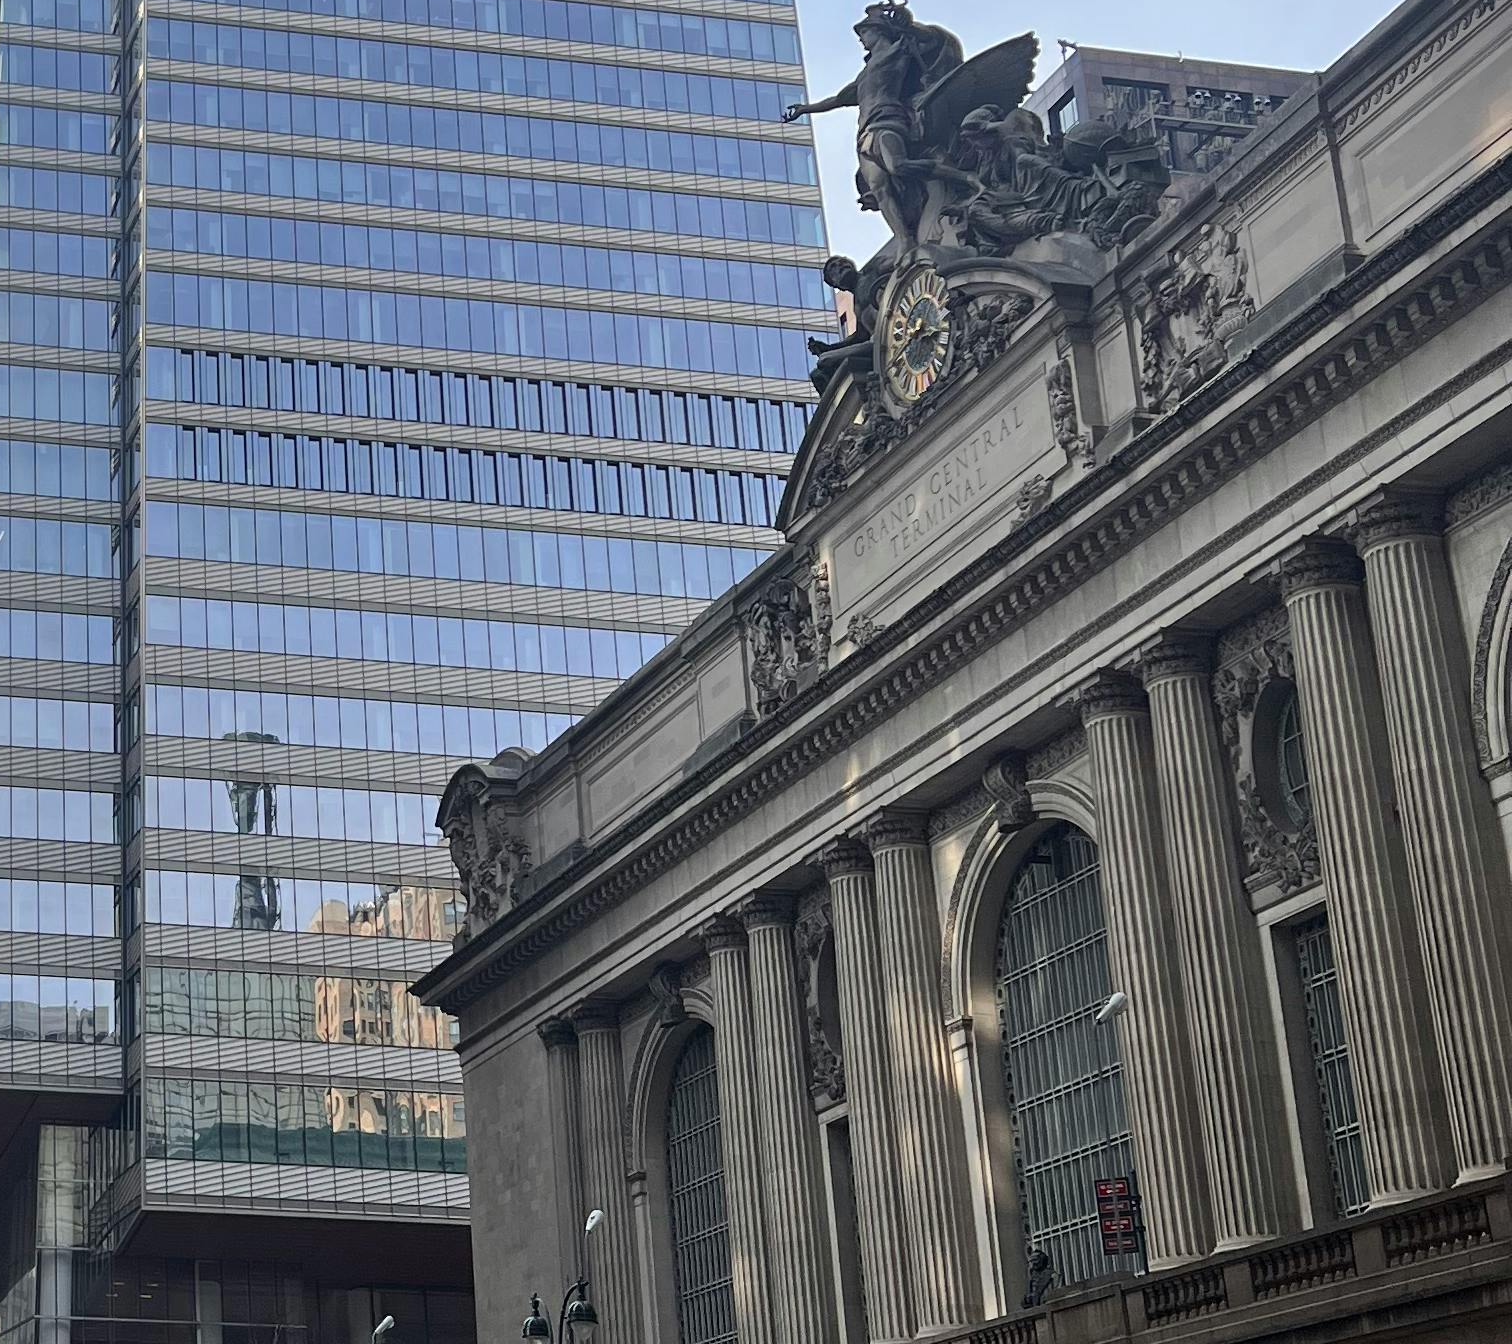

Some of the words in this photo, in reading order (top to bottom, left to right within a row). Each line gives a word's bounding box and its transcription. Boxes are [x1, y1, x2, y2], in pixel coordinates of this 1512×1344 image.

[854, 493, 917, 557] GRAND
[929, 406, 1024, 495] CENTRAL
[890, 468, 987, 558] TERMINAL
